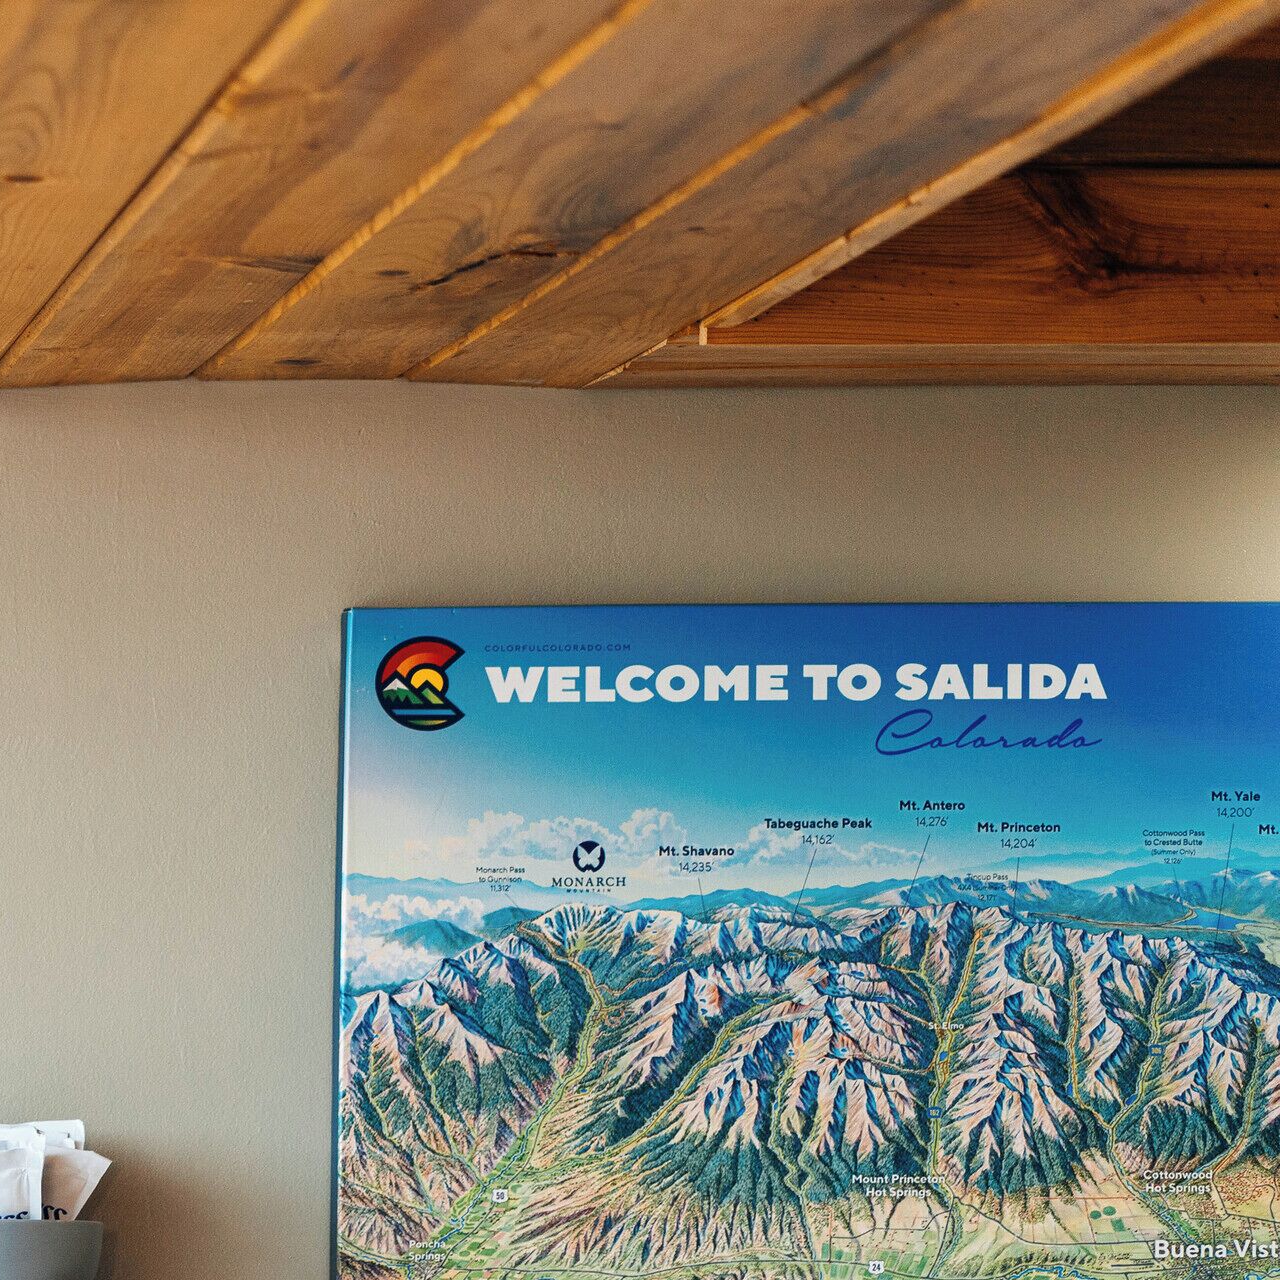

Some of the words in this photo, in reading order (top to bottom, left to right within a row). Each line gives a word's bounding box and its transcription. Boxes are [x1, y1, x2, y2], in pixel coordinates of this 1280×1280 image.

[485, 664, 789, 704] WELCOME
[802, 663, 882, 701] TO
[894, 662, 1108, 701] SALIDA
[875, 708, 1103, 756] Colorado
[1211, 790, 1232, 802] Mt.
[1234, 790, 1261, 802] Yale
[899, 800, 920, 811] Mt.
[922, 800, 966, 811] Antero
[764, 817, 839, 831] Tabeguache
[842, 817, 873, 829] Peak
[977, 822, 998, 833] Mt.
[1001, 821, 1061, 833] Princeton
[1258, 824, 1279, 835] Mt.
[1142, 829, 1188, 837] Cottonwood
[1188, 829, 1205, 837] Pass
[1153, 838, 1181, 846] Crested
[659, 845, 679, 857] Mt.
[682, 845, 735, 857] Shavano
[476, 866, 508, 874] Monarch
[509, 866, 526, 874] Pass
[479, 875, 486, 883] to
[487, 875, 523, 883] Gunnison
[551, 876, 627, 888] MONARCH
[992, 873, 1009, 881] Pass
[928, 1022, 941, 1030] St.
[942, 1022, 965, 1030] Elmo
[852, 1174, 889, 1184] Mount
[891, 1174, 946, 1184] Princeton
[1143, 1170, 1213, 1180] Cottonwood
[866, 1188, 886, 1197] Hot
[889, 1187, 931, 1198] Springs
[1145, 1184, 1166, 1193] Hot
[1168, 1183, 1211, 1195] Springs
[409, 1240, 446, 1249] Poncha
[1154, 1239, 1228, 1259] Buena
[408, 1252, 446, 1261] Springs
[871, 1263, 882, 1272] 24
